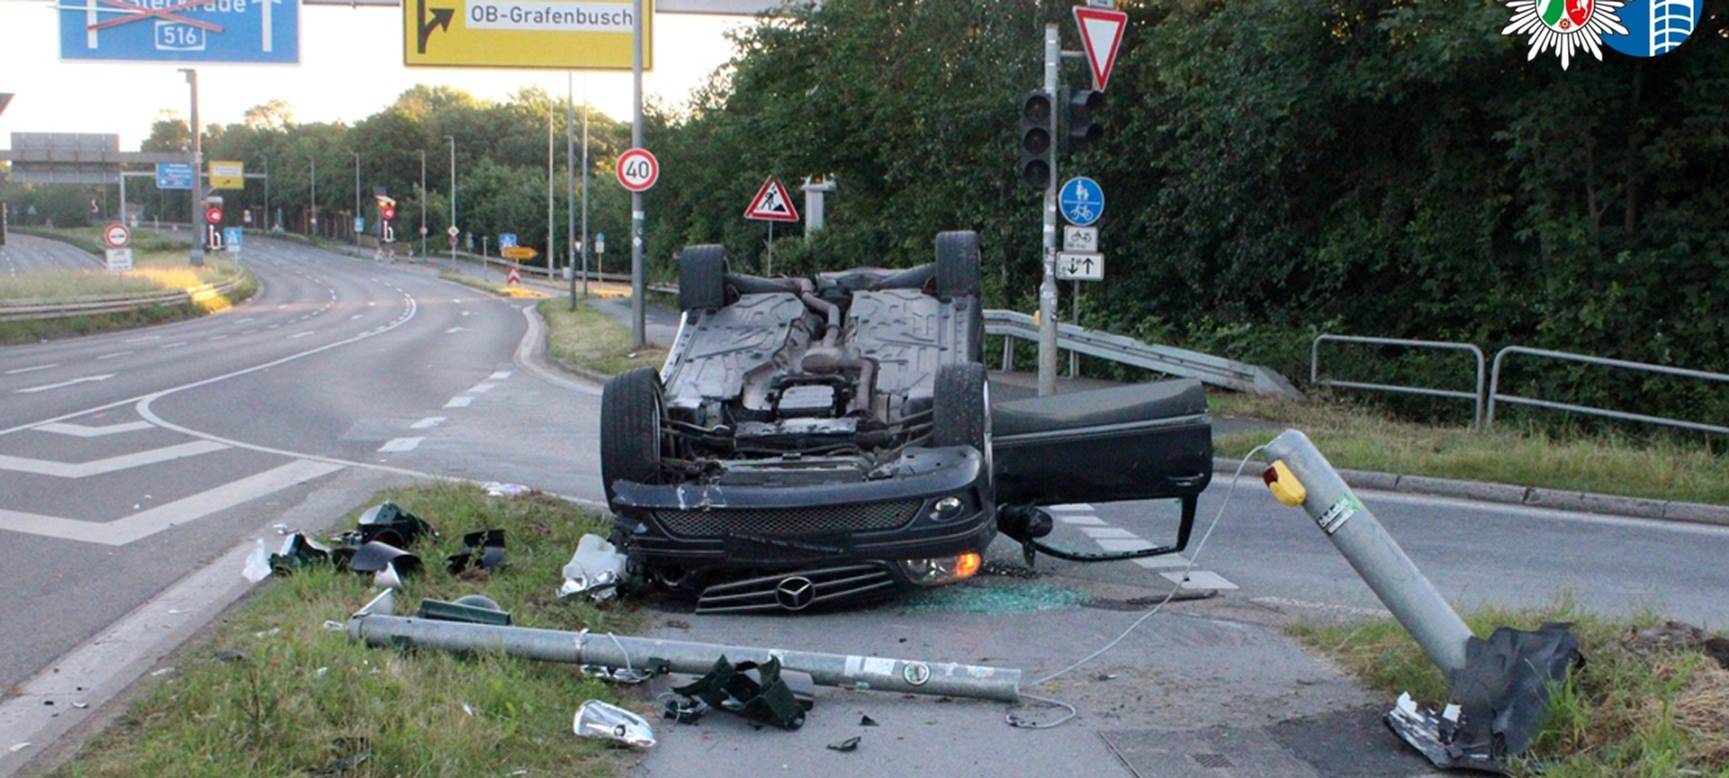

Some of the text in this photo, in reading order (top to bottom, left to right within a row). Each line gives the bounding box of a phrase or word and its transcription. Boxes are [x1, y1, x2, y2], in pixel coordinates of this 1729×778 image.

[471, 5, 633, 25] OB-Grafenbusch
[164, 27, 196, 44] 516
[626, 161, 649, 179] 40
